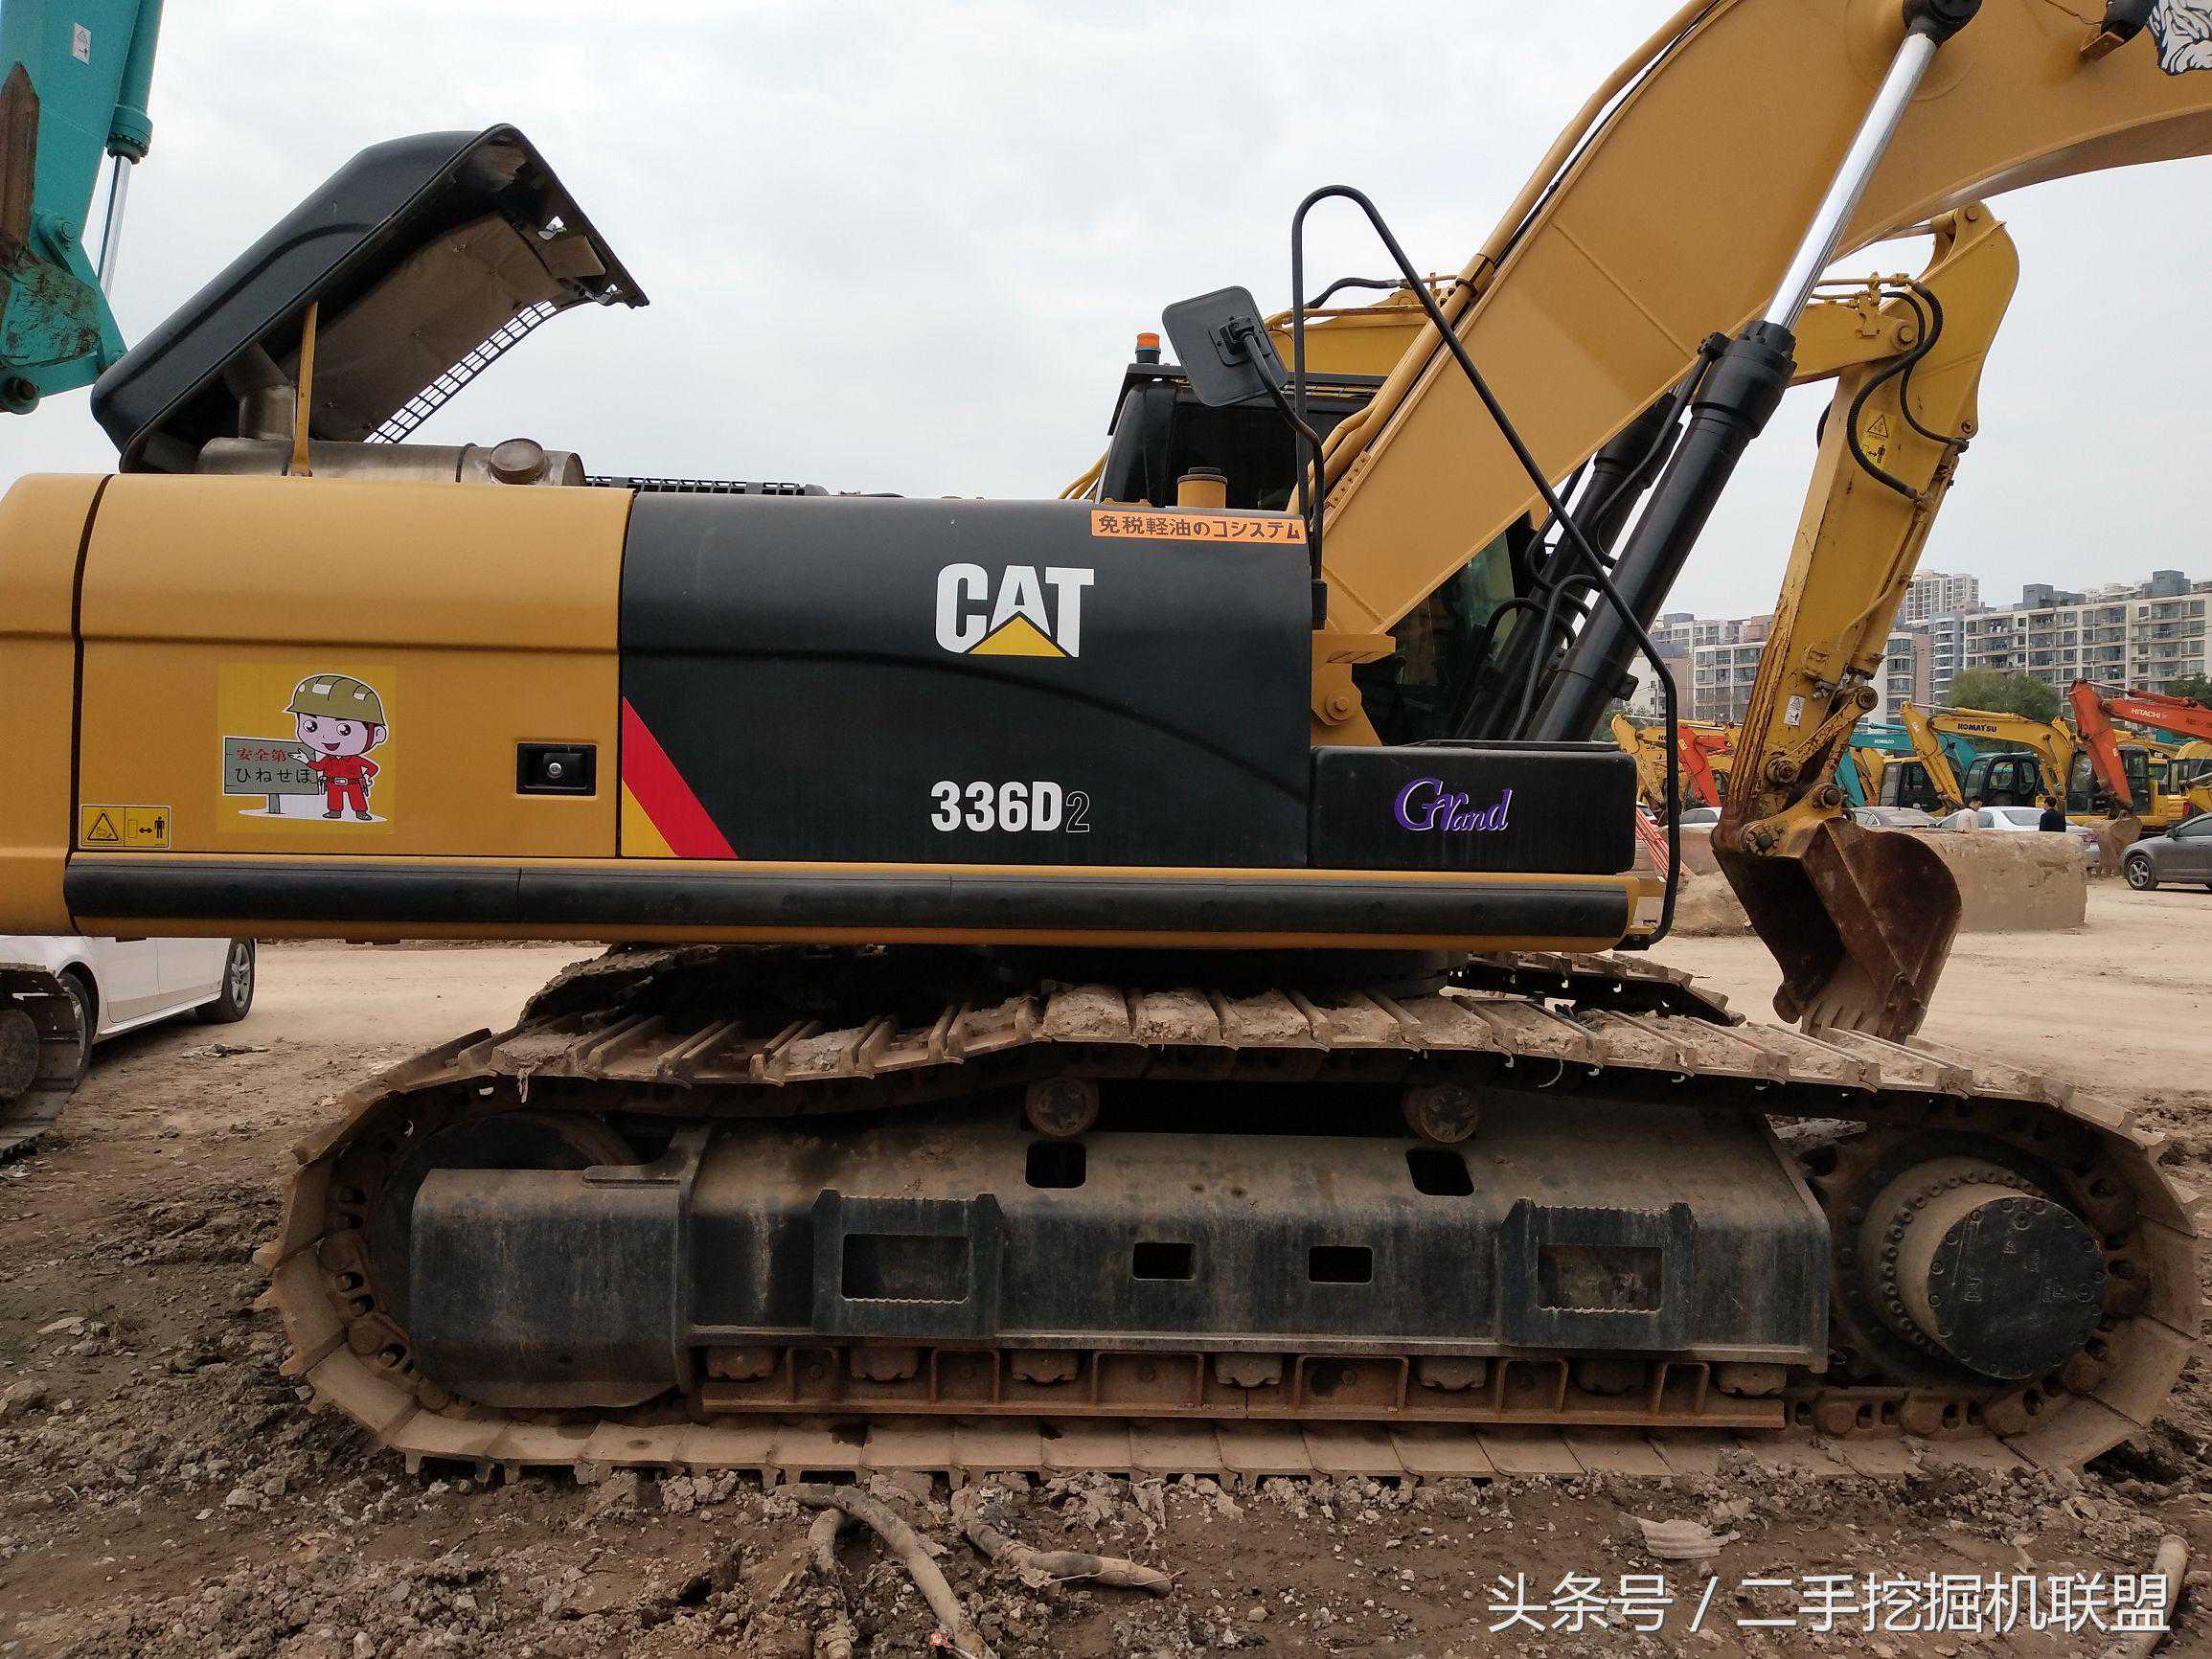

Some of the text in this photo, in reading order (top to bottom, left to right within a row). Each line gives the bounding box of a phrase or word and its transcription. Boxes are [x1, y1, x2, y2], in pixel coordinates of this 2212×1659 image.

[935, 563, 1095, 658] CAT
[1957, 722, 1997, 733] KOMATSU
[2131, 708, 2161, 719] HITACHI
[1394, 777, 1513, 831] Grand
